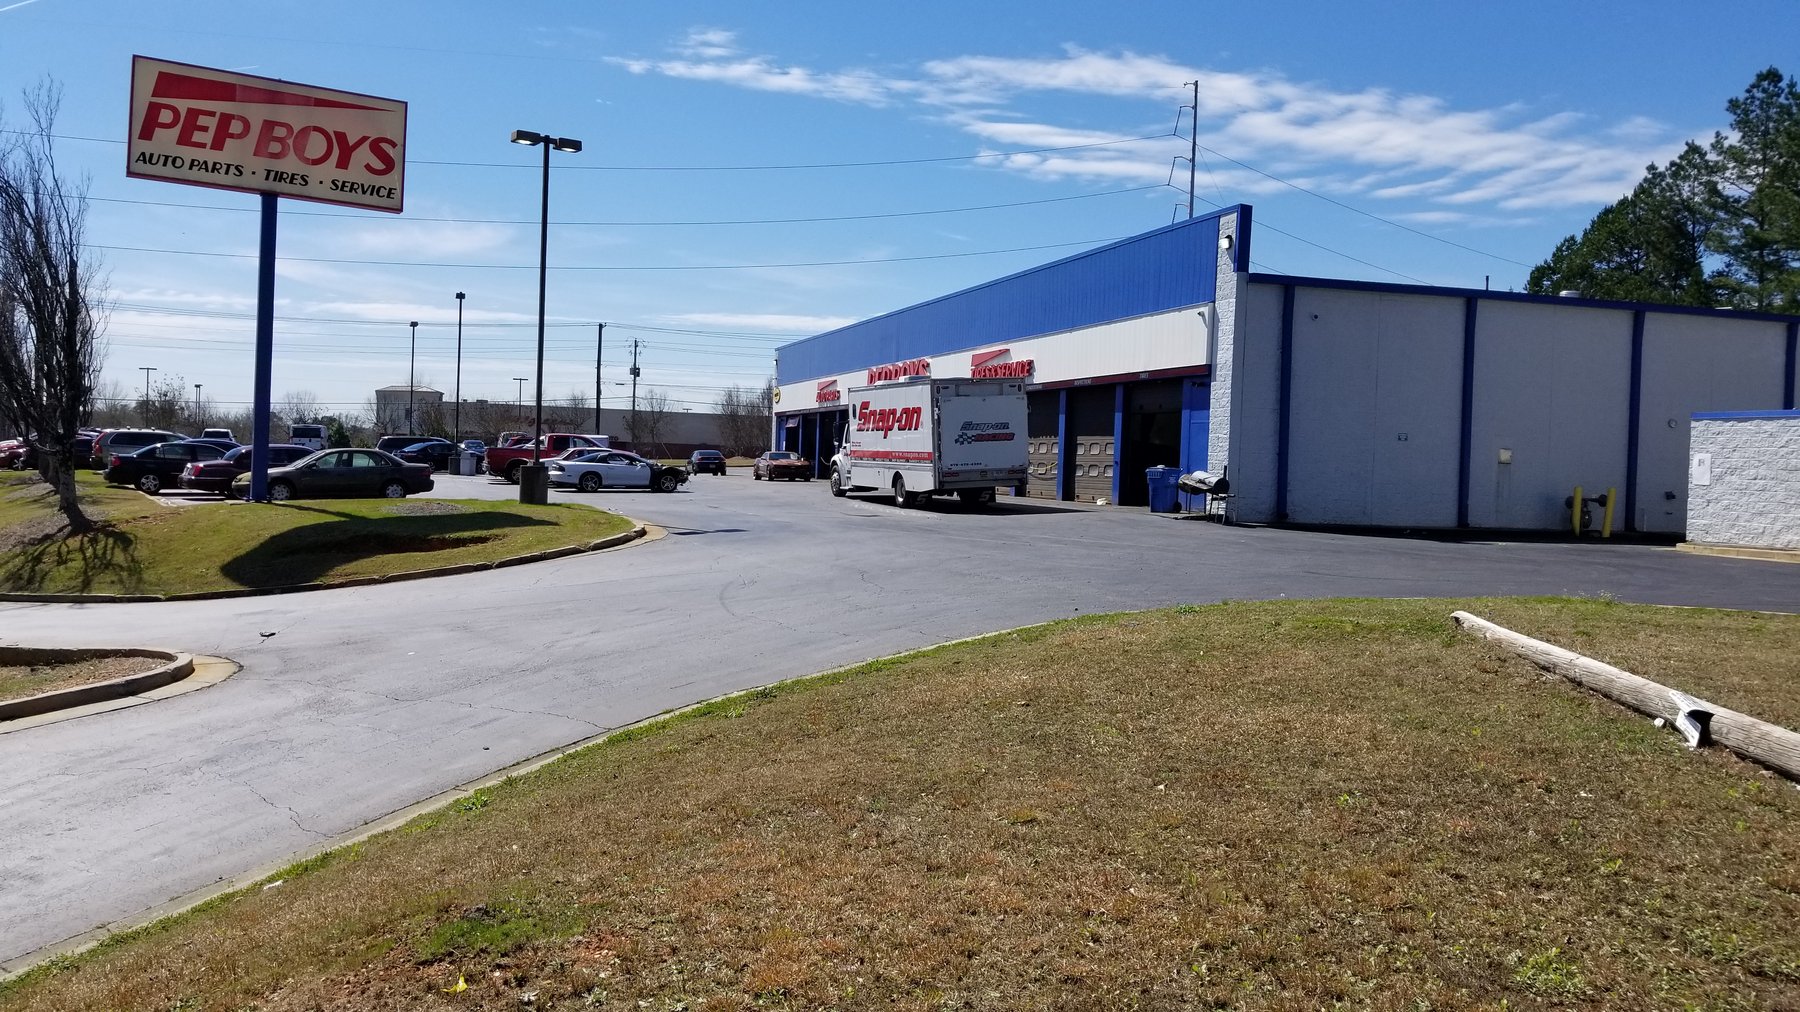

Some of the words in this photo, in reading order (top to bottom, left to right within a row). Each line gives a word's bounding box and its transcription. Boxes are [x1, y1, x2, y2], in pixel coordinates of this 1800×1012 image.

[138, 101, 251, 151] PEP
[253, 119, 398, 176] BOYS
[135, 151, 185, 169] AUTO
[188, 158, 244, 177] PARTS
[264, 168, 309, 186] TIRES
[330, 178, 397, 200] SERVICE
[857, 400, 922, 439] Snap-on
[960, 421, 1010, 433] Snap-on
